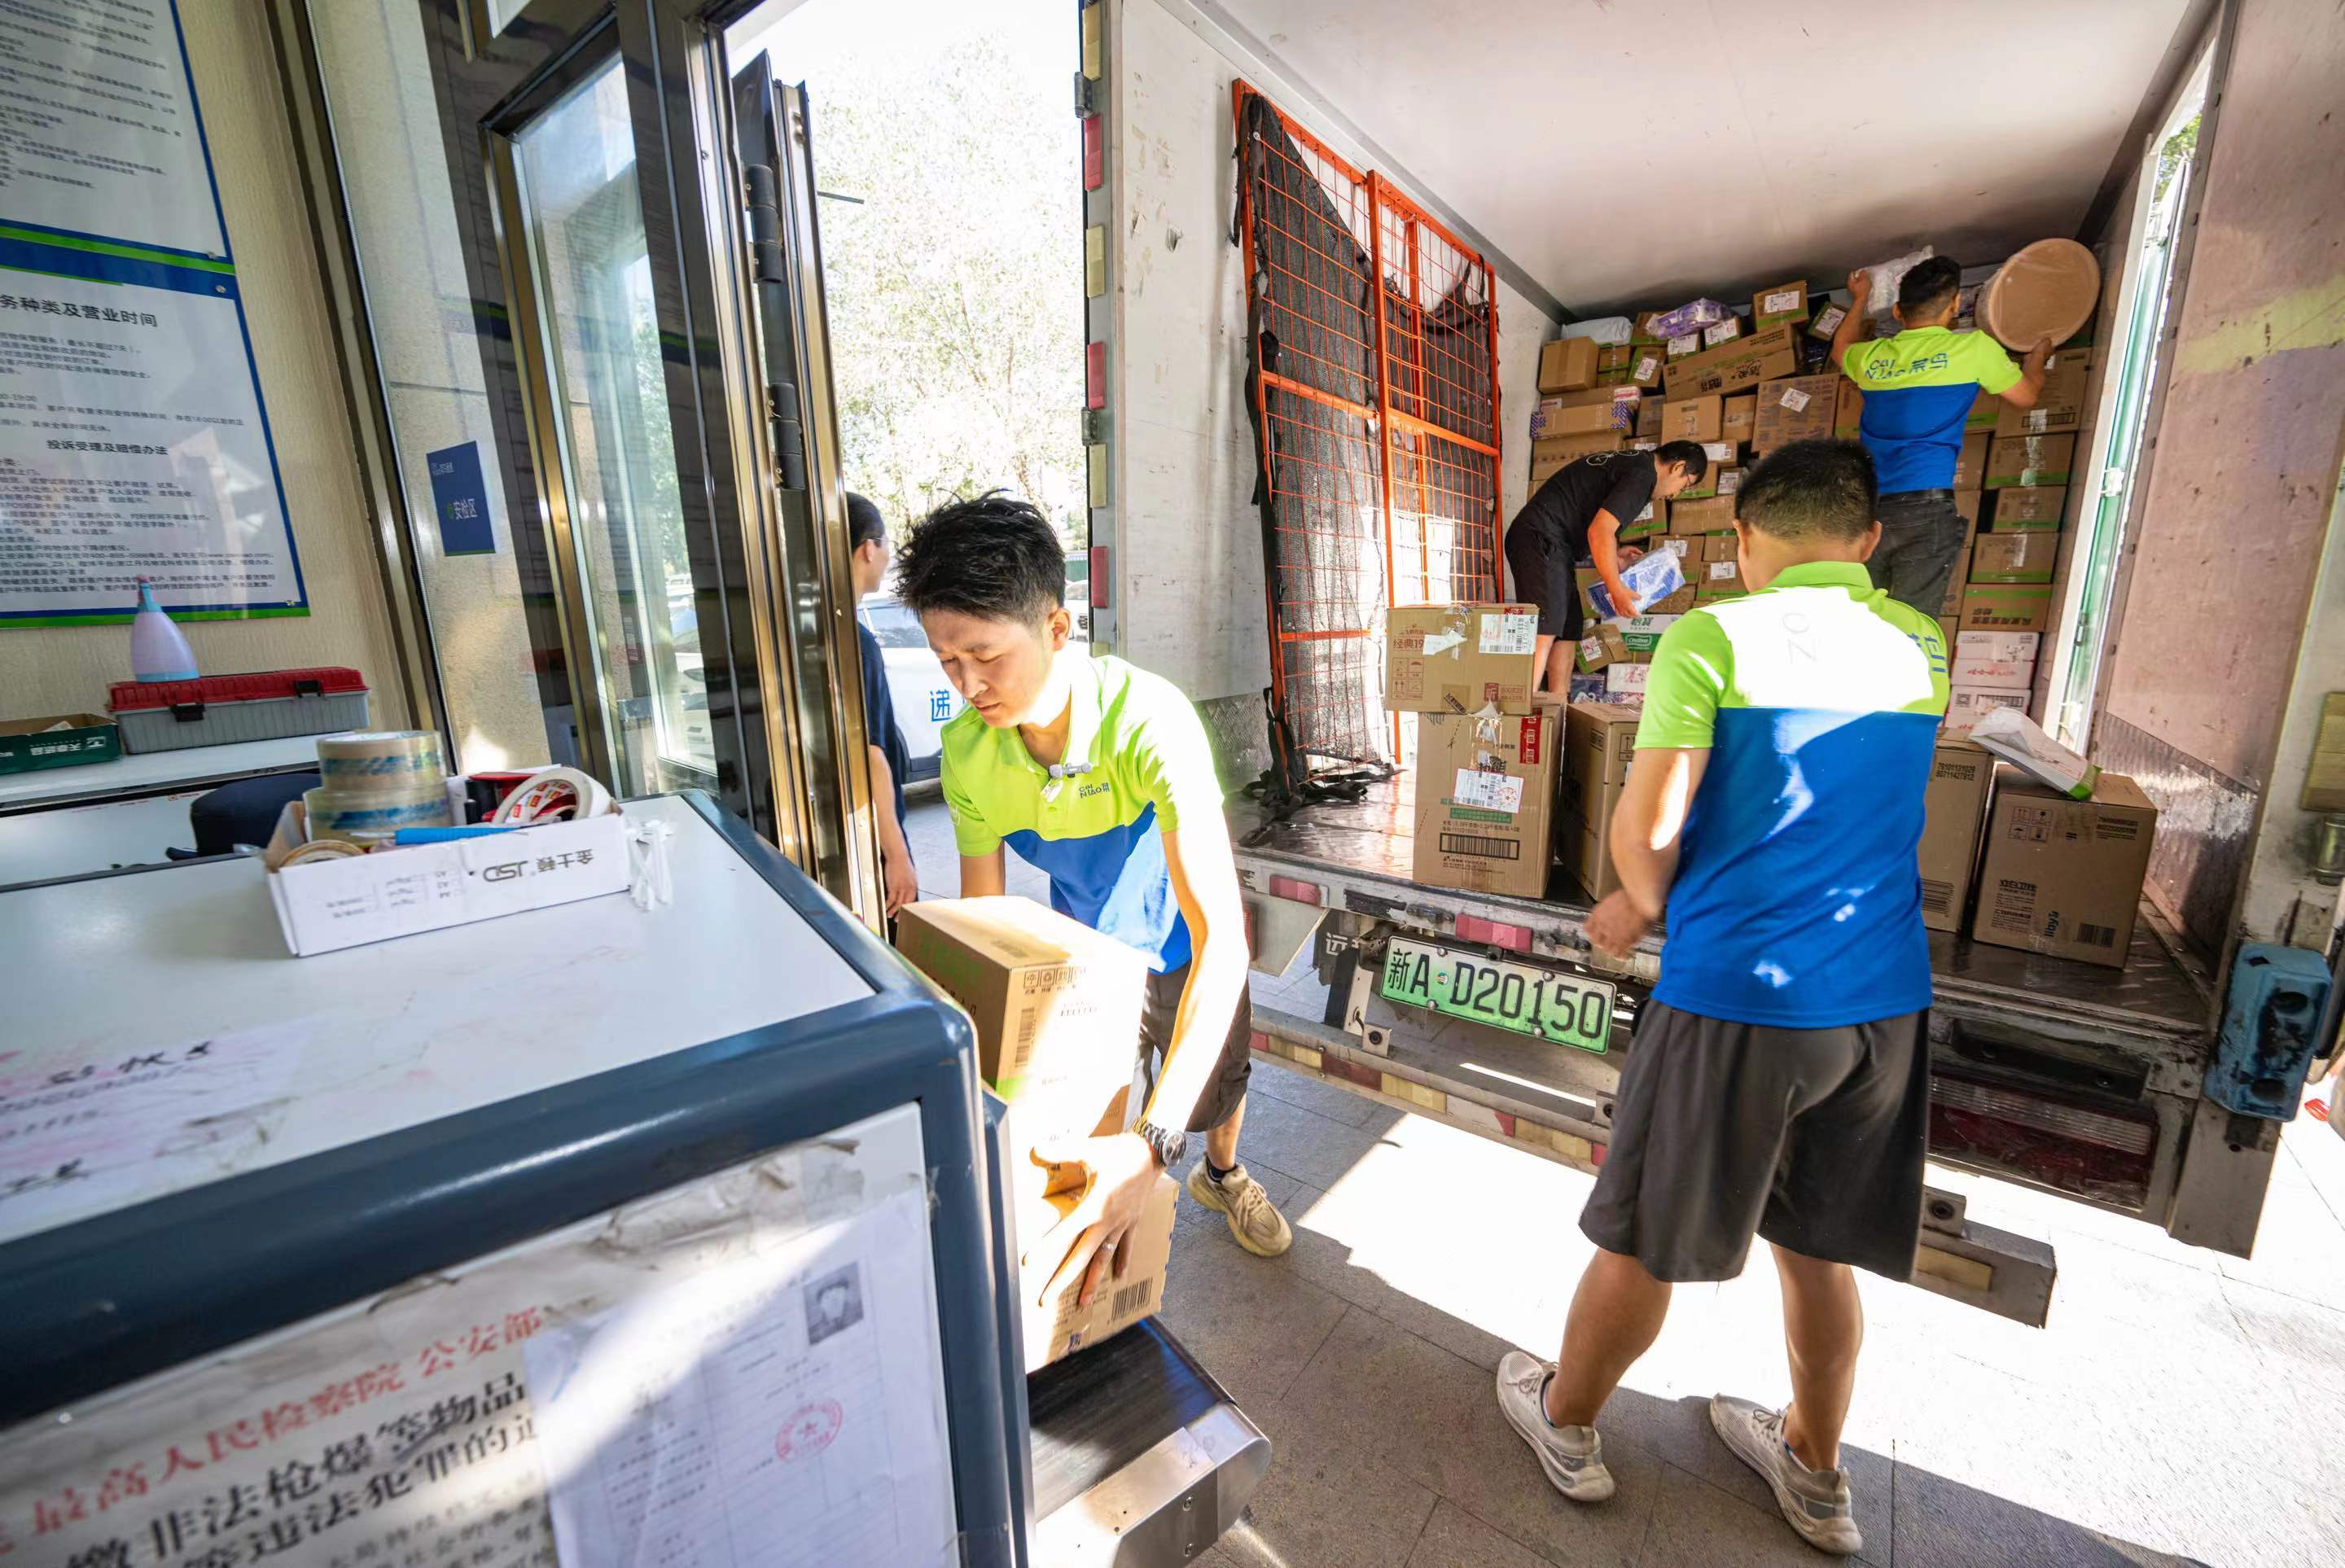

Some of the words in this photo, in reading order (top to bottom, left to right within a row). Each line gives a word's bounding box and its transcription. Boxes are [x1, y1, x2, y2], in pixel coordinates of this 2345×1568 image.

[0, 294, 158, 327] 务种类及营业时间
[46, 440, 169, 455] 投诉受理及赔偿办法
[930, 689, 952, 722] 递
[483, 860, 528, 883] JSD
[537, 848, 594, 873] 金士顿
[1326, 931, 1359, 956] 远
[1387, 950, 1430, 997] 新A
[1449, 961, 1606, 1040] D20150
[33, 1363, 405, 1536] 最高人民检察院
[419, 1306, 541, 1377] 公安部
